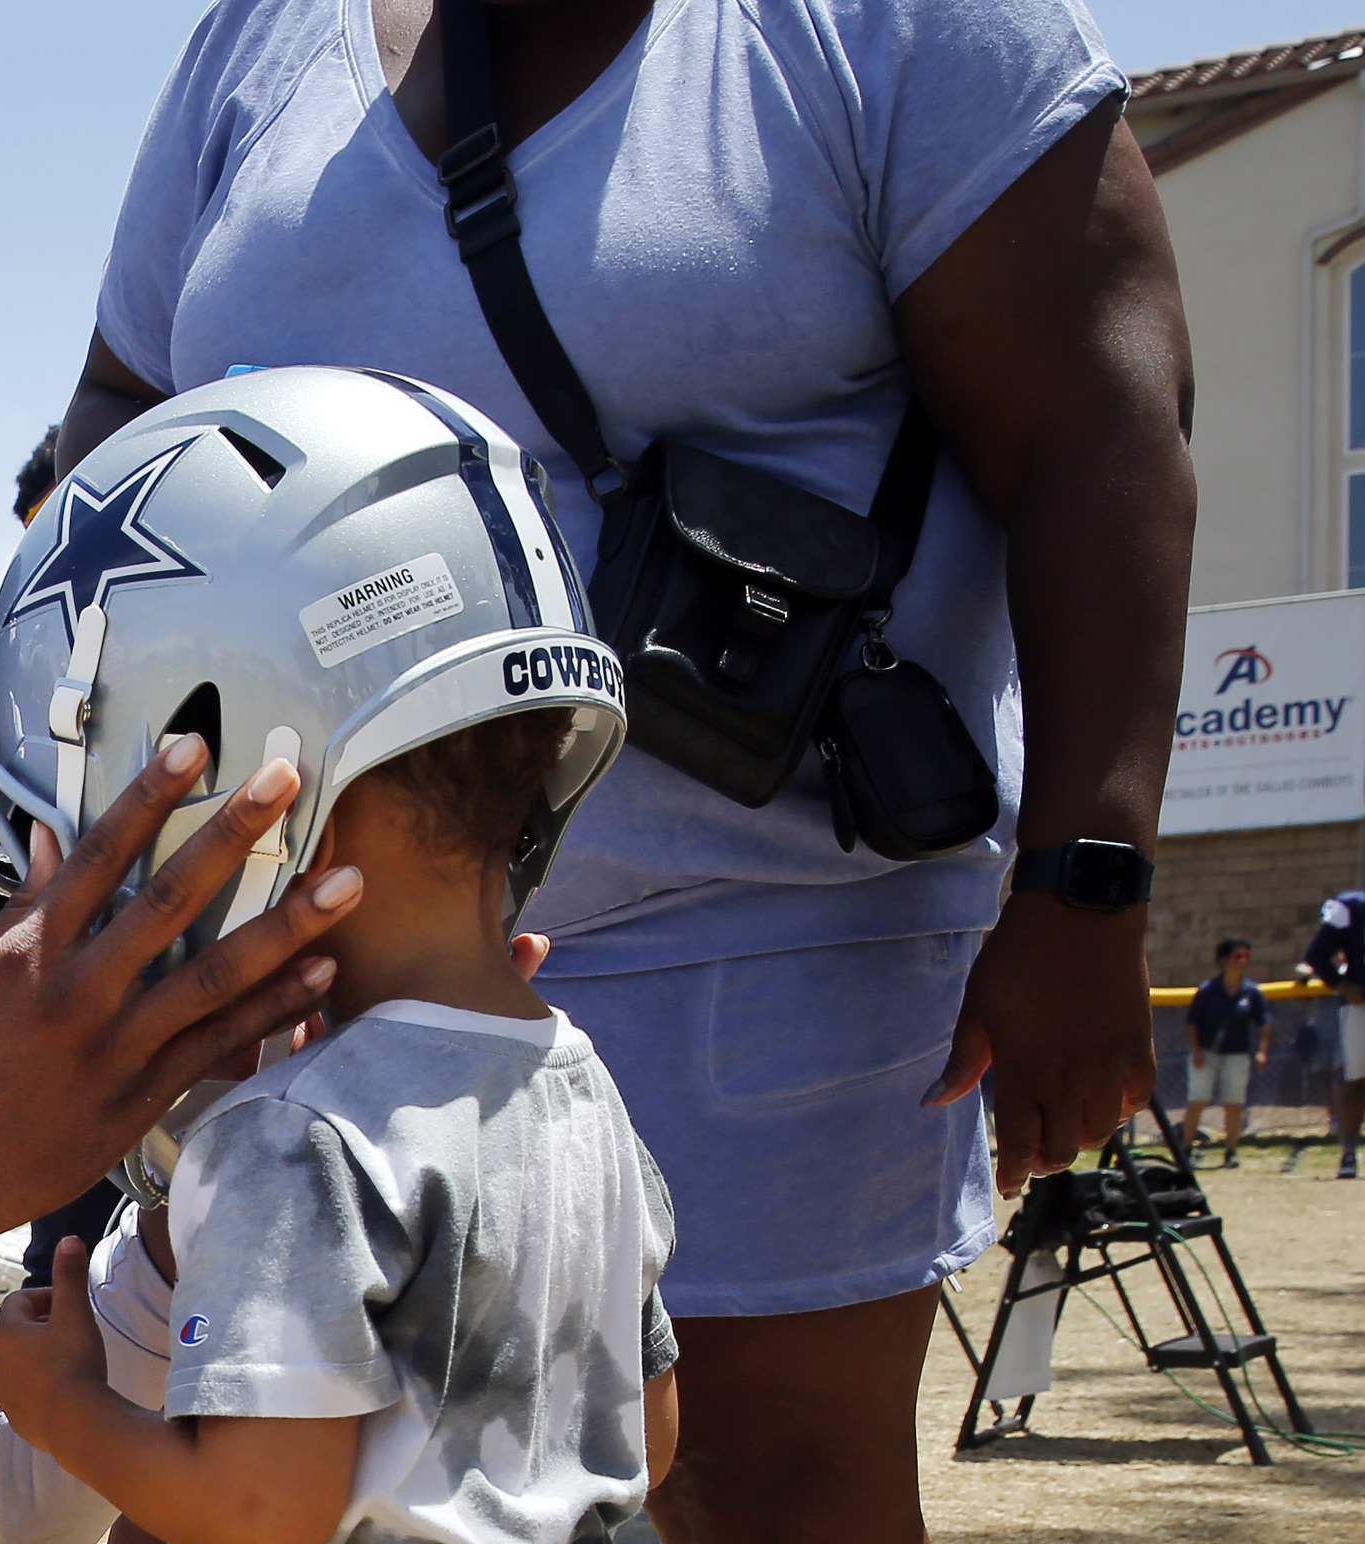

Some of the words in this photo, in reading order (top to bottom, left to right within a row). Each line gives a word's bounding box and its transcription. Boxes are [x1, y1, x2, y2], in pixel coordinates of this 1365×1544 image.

[311, 626, 326, 637] THIS
[326, 614, 352, 630] REPLICA
[352, 603, 376, 618] HELMET
[376, 599, 384, 607] IS
[384, 594, 397, 603] FOR
[396, 584, 420, 599] DISPLAY
[315, 635, 329, 646] NOT
[331, 620, 362, 638] DESIGNED
[364, 614, 375, 623] OR
[377, 600, 406, 617] INTENDED
[408, 595, 421, 604] FOR
[423, 589, 435, 599] USE
[437, 585, 446, 593] AS
[337, 568, 414, 610] WARNING
[319, 632, 356, 655] PROTECTIVE
[383, 617, 392, 626] DO
[392, 611, 404, 621] NOT
[405, 604, 421, 616] WEAR
[421, 600, 434, 609] THIS
[434, 592, 455, 604] HELMET
[1175, 696, 1348, 737] cademy
